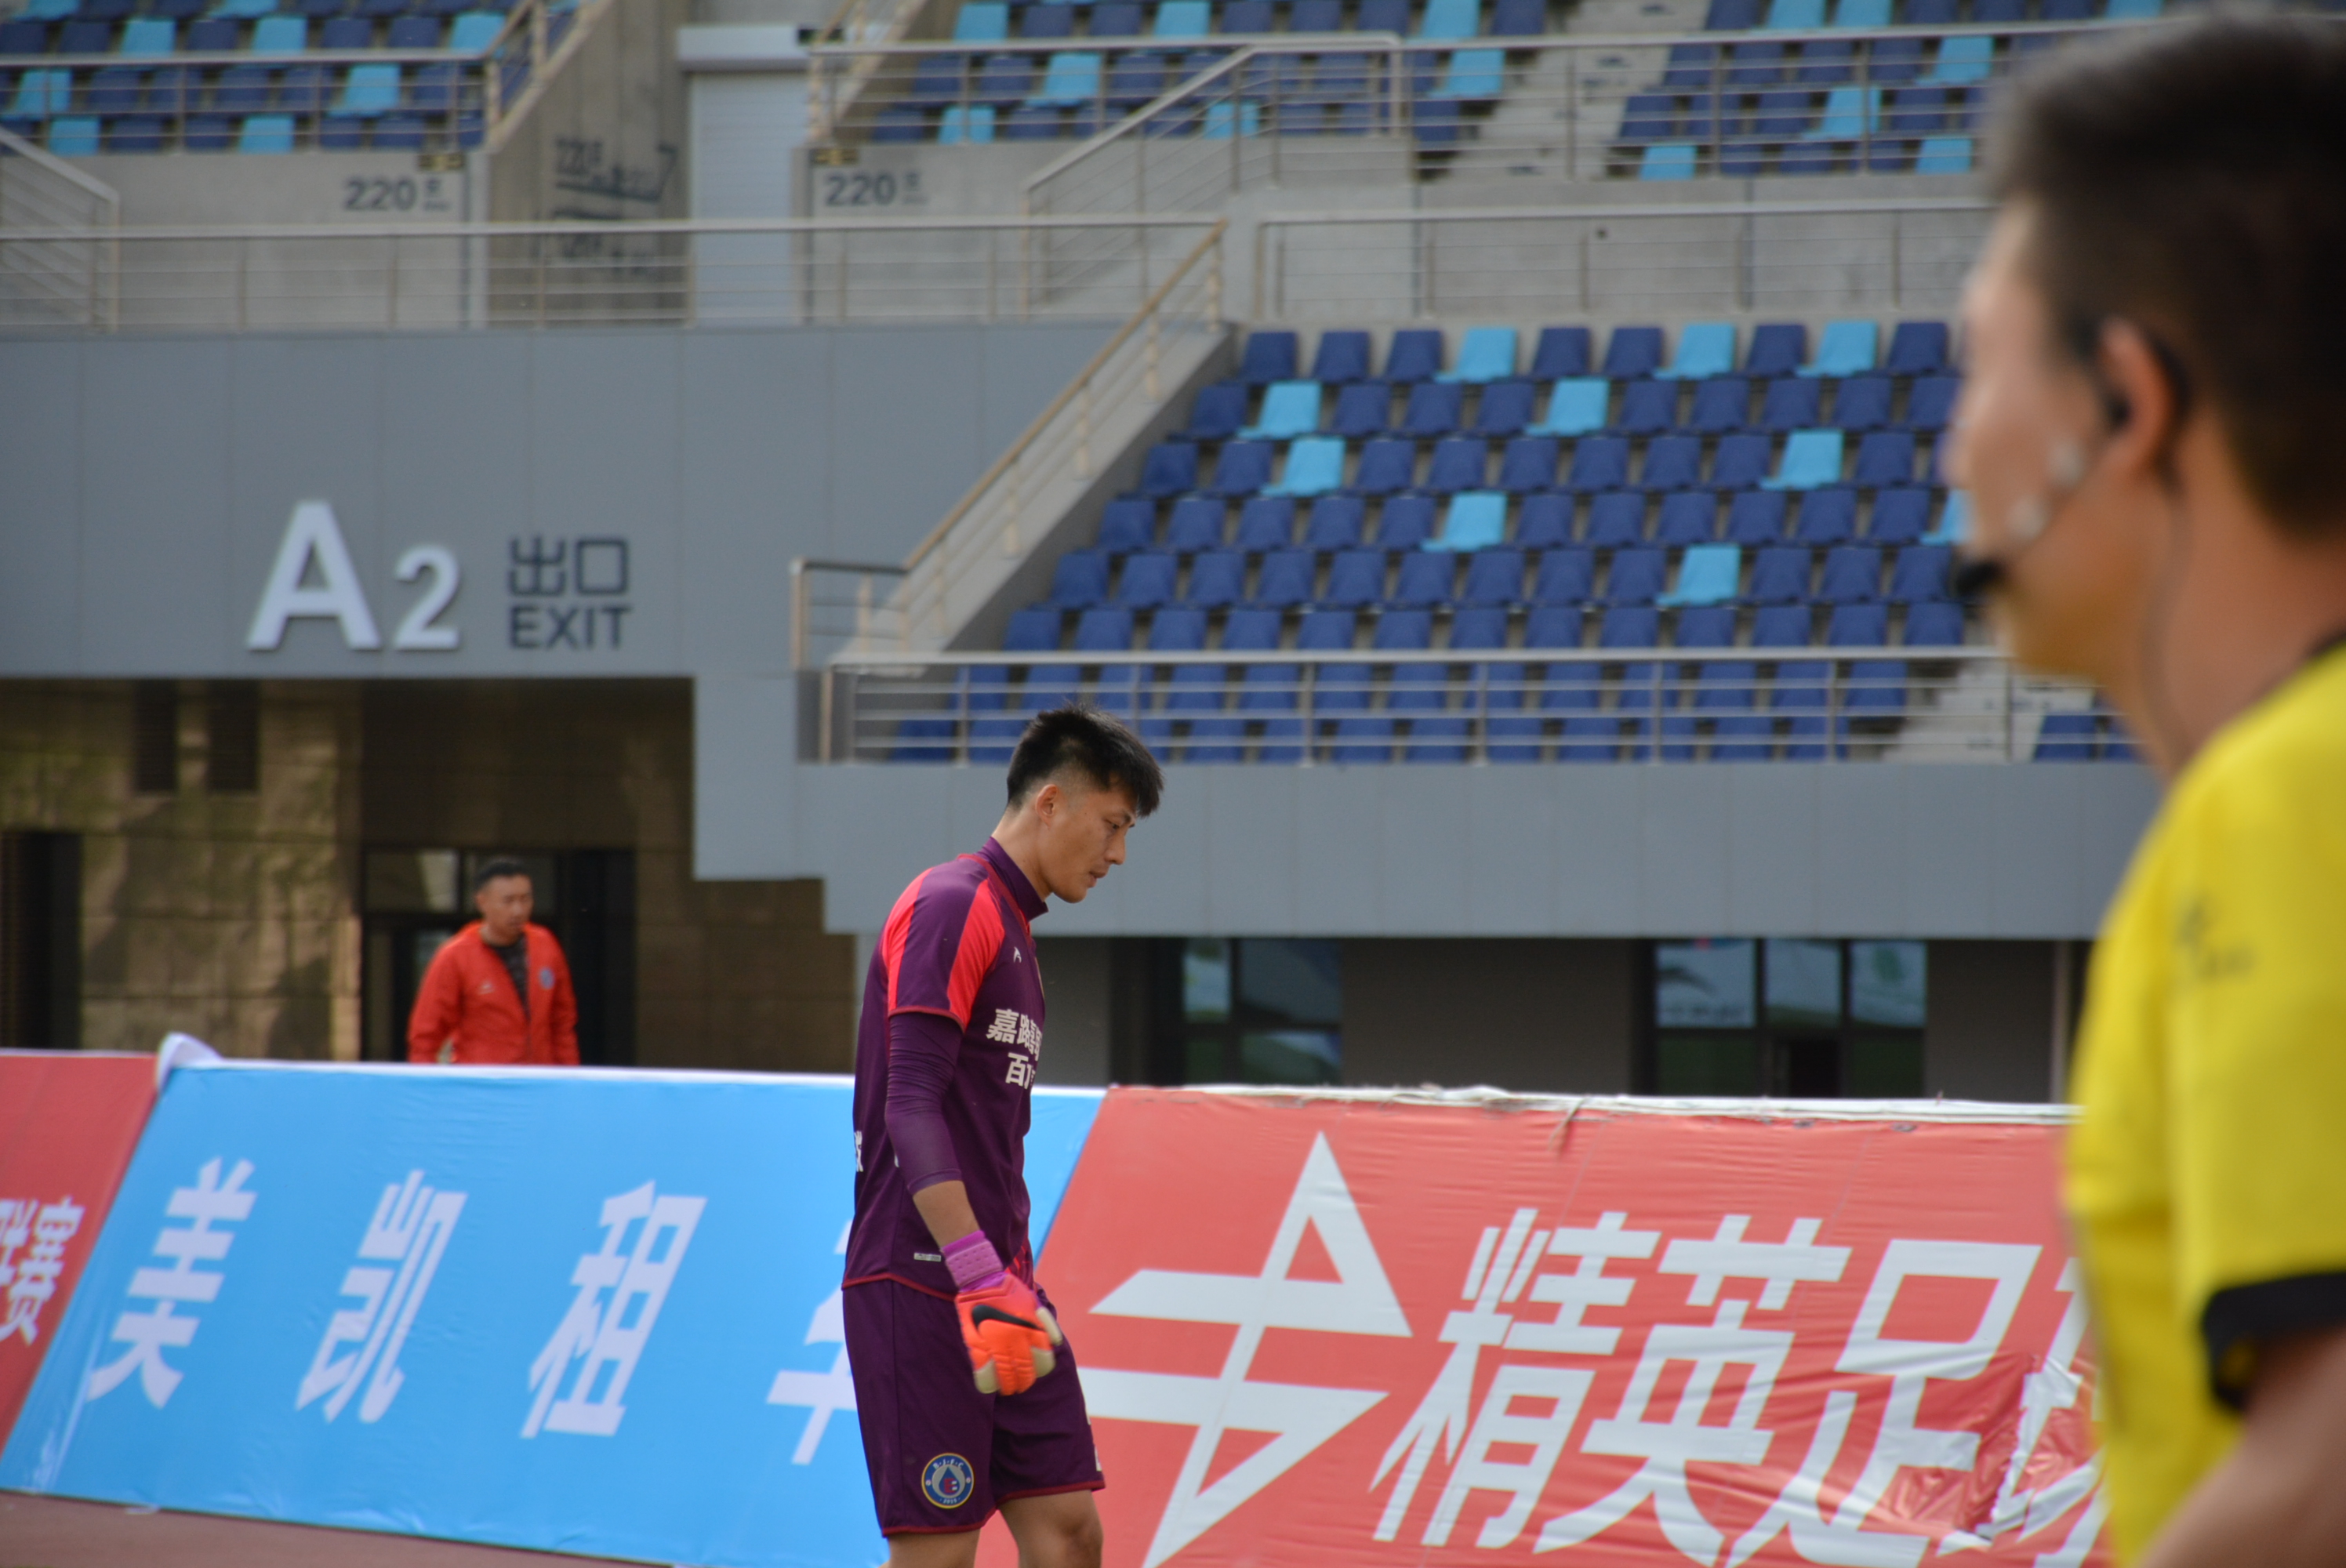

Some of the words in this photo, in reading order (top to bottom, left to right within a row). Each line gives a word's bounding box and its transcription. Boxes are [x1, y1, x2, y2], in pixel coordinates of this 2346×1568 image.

[345, 178, 417, 211] 220
[826, 172, 896, 205] 220
[246, 500, 461, 652] A2
[507, 535, 630, 596] 出口
[509, 605, 632, 649] EXIT
